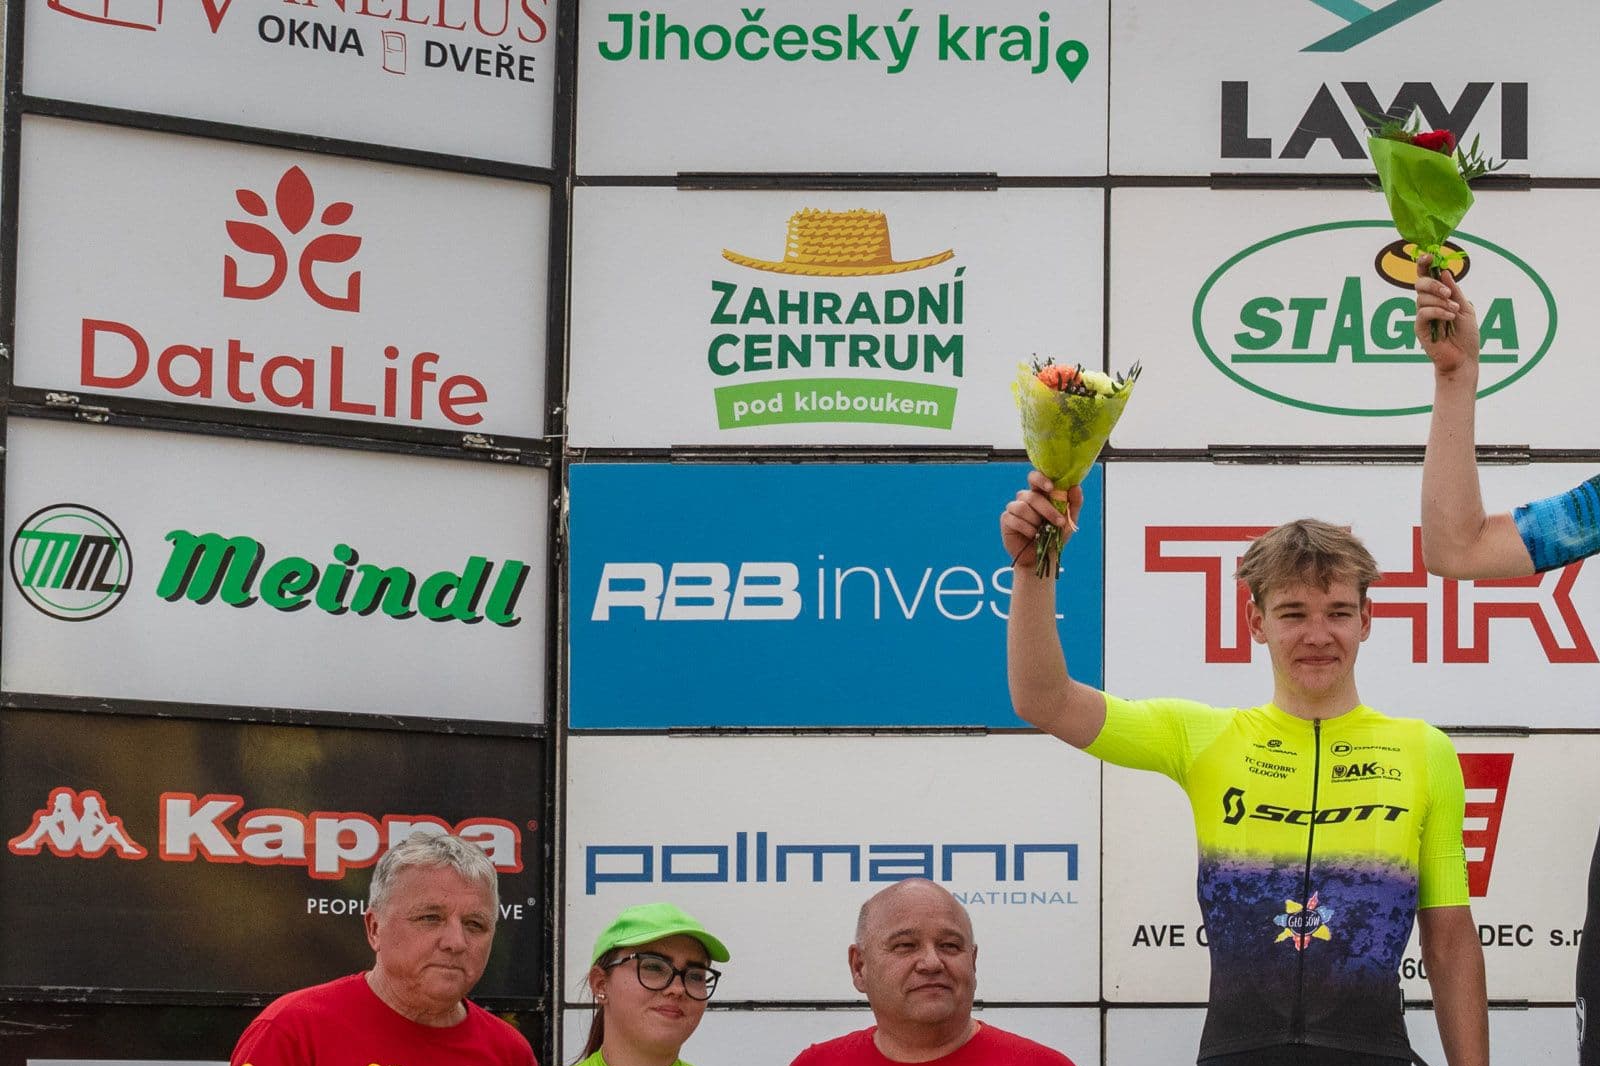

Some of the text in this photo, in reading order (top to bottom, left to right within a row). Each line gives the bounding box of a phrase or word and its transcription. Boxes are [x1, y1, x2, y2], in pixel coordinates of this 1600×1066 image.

[257, 14, 535, 83] OKNA DVEŘE
[598, 8, 1051, 75] Jihočeský kraj
[710, 266, 967, 325] ZAHRADNÍ
[1232, 276, 1519, 363] STAGA
[80, 317, 488, 426] DataLife
[707, 333, 964, 378] CENTRUM
[733, 391, 939, 421] pod kloboukem
[156, 530, 531, 628] Meindl
[591, 555, 1064, 621] RBB inves
[1249, 804, 1409, 826] SCOTT
[586, 832, 1078, 896] pollmann
[307, 898, 368, 916] PEOPL
[1132, 925, 1185, 947] AVE
